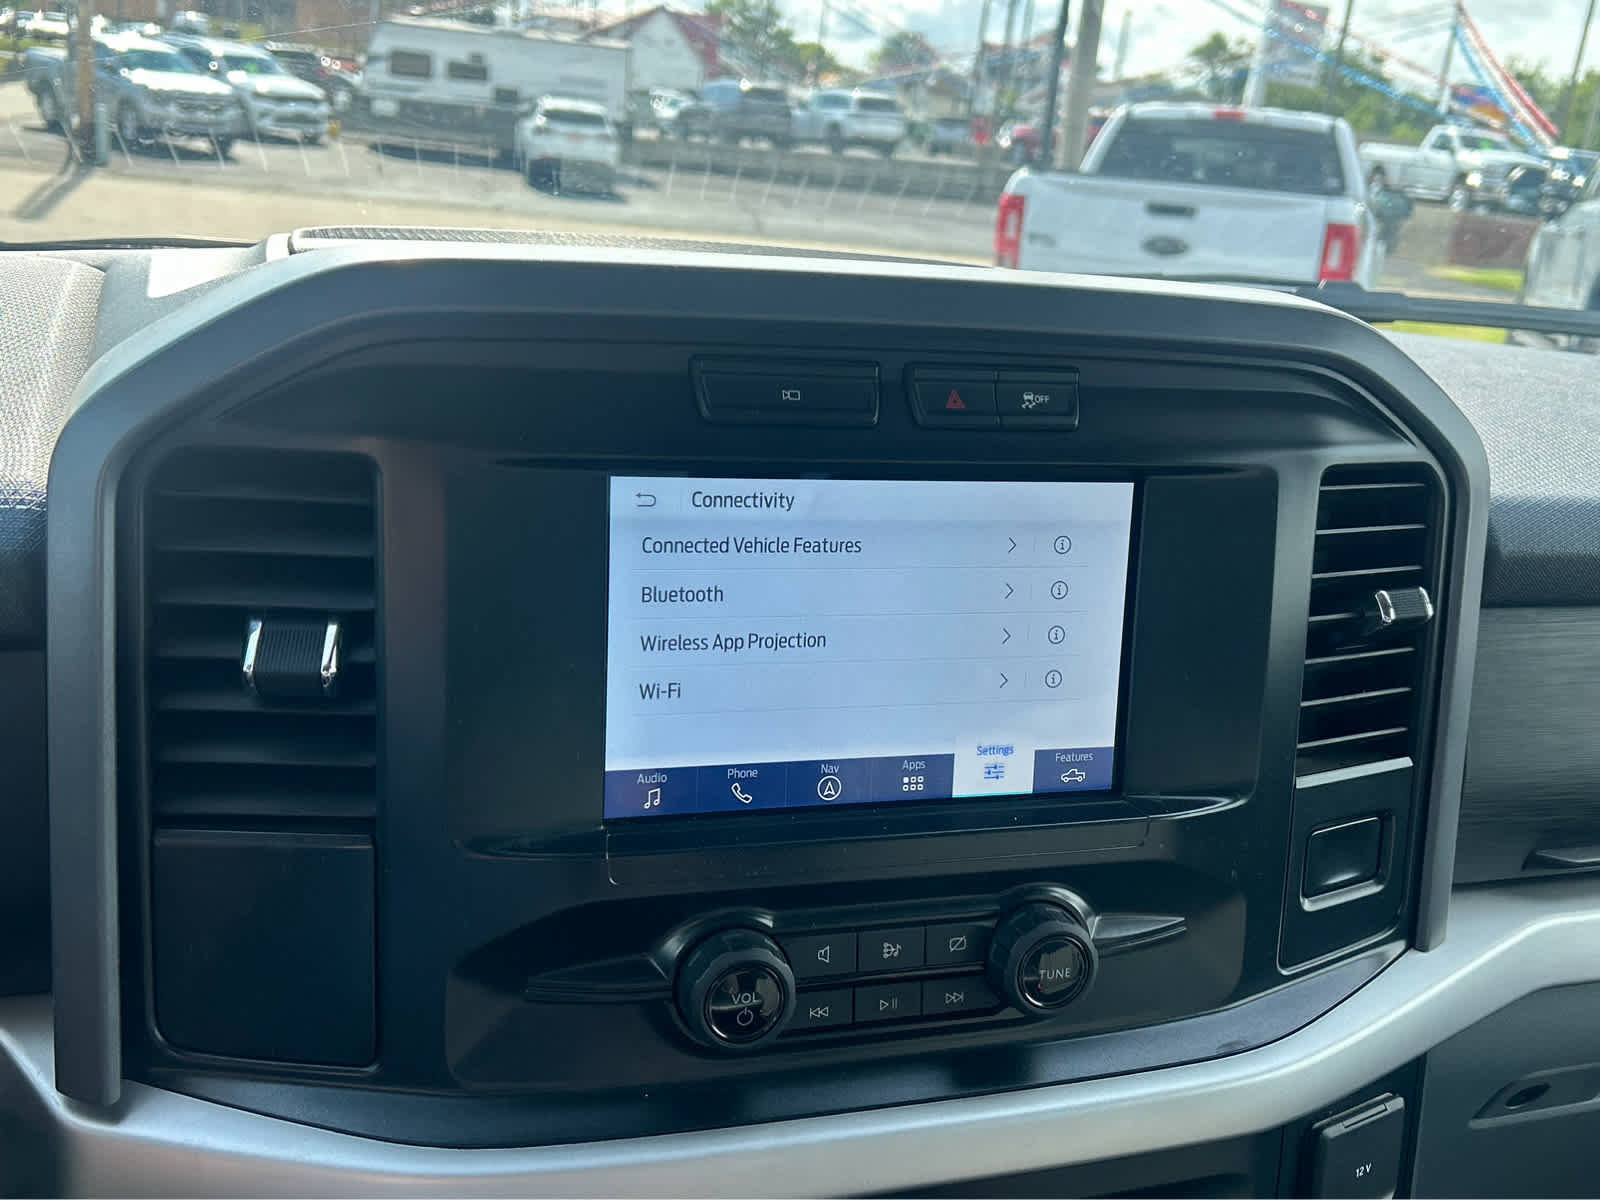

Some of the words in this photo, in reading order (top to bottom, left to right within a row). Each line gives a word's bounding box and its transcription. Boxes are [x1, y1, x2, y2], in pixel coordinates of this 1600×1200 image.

[1034, 394, 1049, 404] OFF
[691, 491, 795, 511] Connectivity
[641, 536, 730, 554] Connected
[733, 536, 790, 554] Vehicle
[793, 536, 863, 554] Features
[640, 585, 724, 603] Bluetooth
[640, 633, 709, 652] Wireless
[712, 633, 745, 653] App
[747, 631, 827, 652] Projection
[639, 682, 682, 700] Wi-Fi
[976, 744, 1015, 758] Settings
[1055, 751, 1095, 763] Features
[820, 763, 840, 775] Nav
[902, 760, 926, 771] Apps
[636, 772, 668, 785] Audio
[727, 767, 758, 779] Phone
[1039, 967, 1072, 980] TUNE
[731, 991, 762, 1005] VOL
